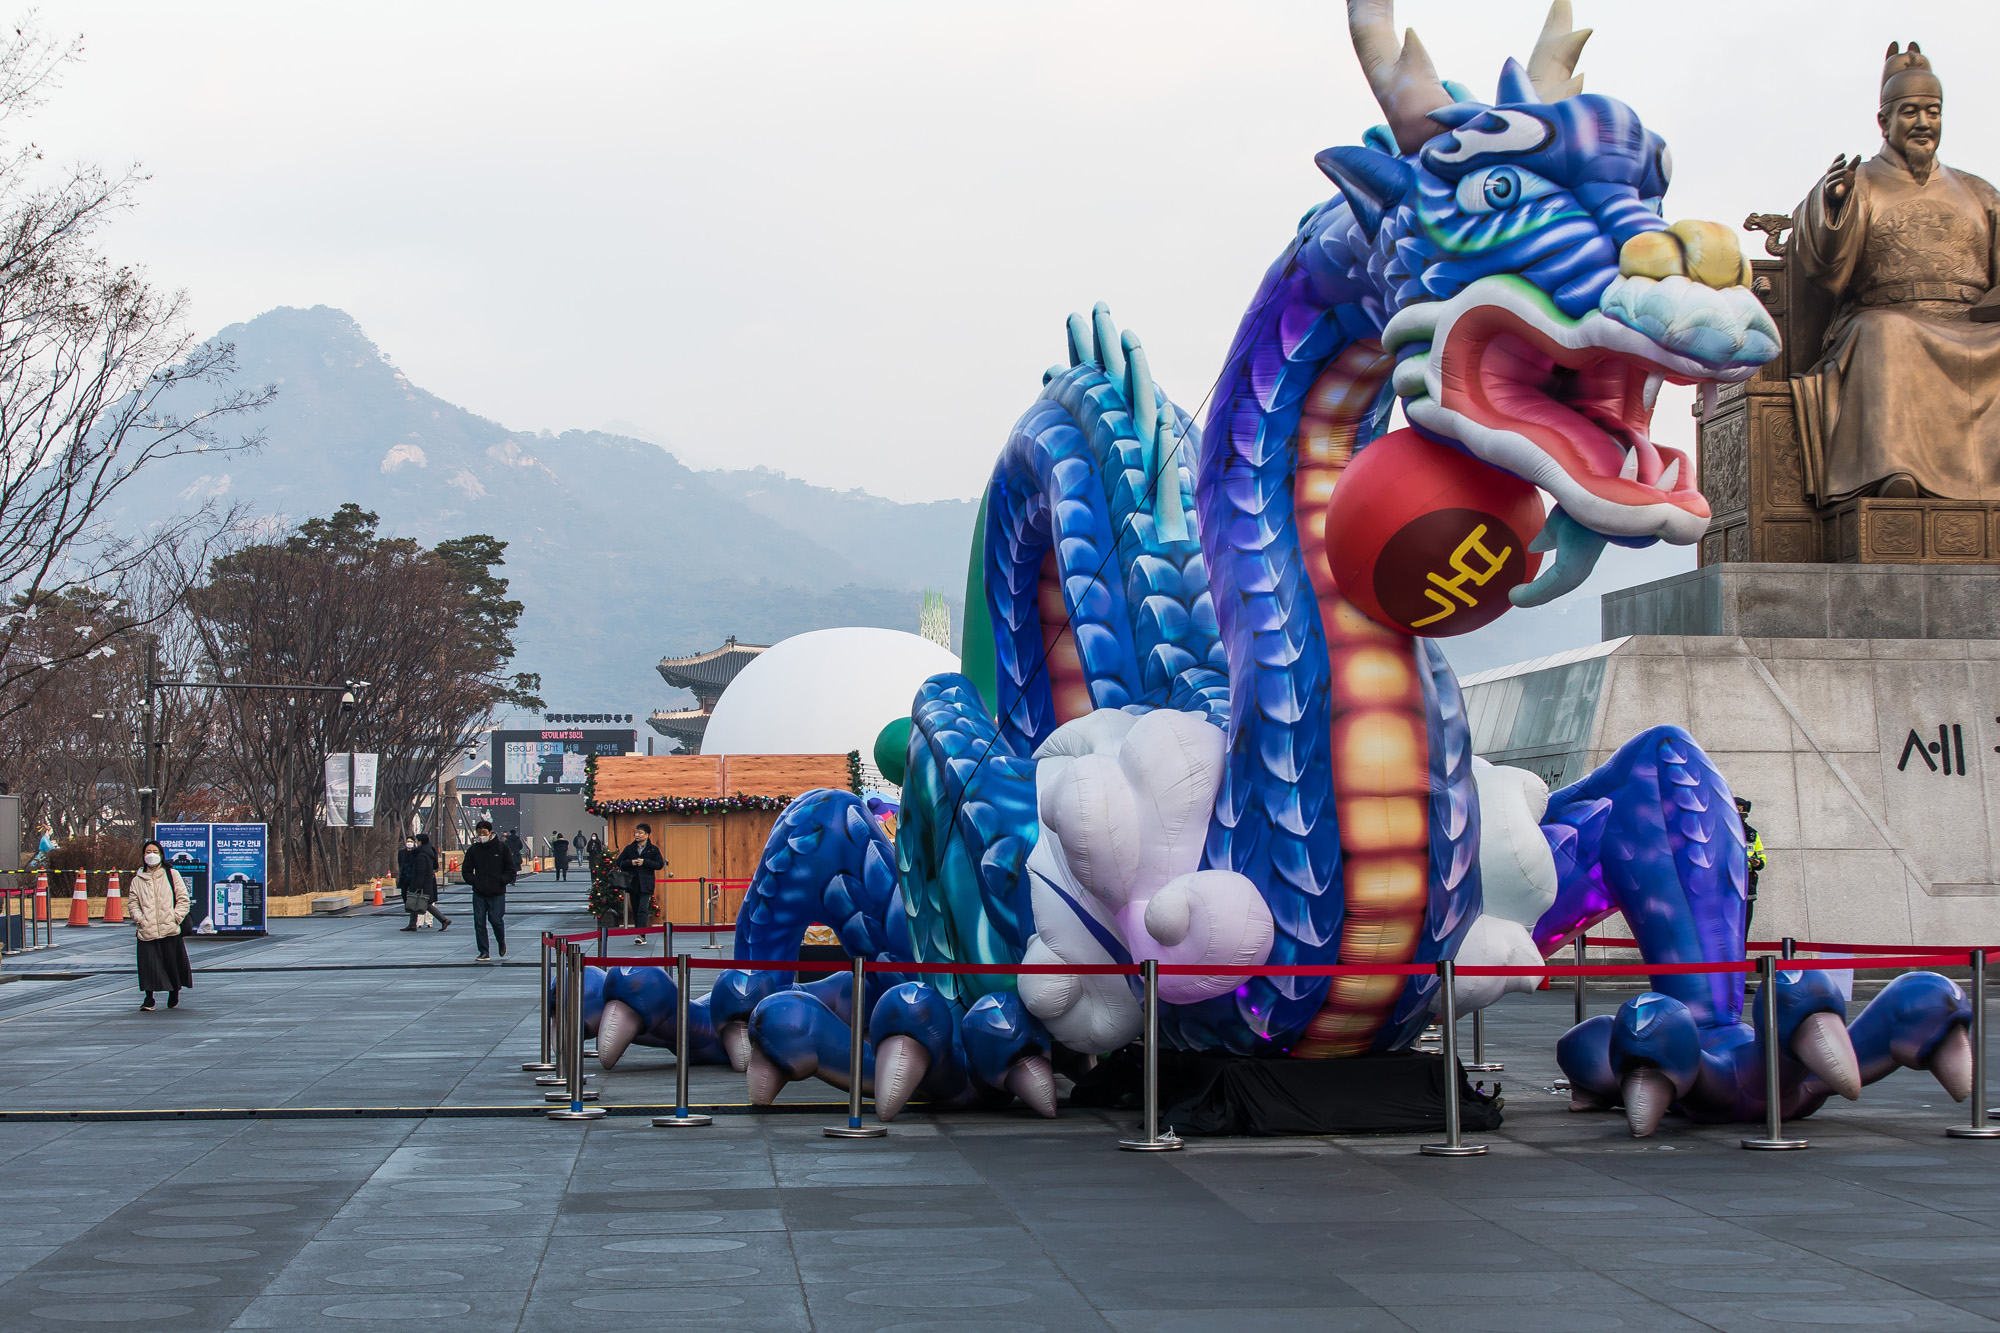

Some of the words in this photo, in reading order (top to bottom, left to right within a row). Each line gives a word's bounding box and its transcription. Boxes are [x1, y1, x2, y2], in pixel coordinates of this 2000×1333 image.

[1410, 523, 1512, 628] 복
[541, 731, 559, 739] SEOUL
[559, 731, 568, 739] MY
[568, 731, 584, 739] SOUL
[507, 743, 534, 753] Seoul
[536, 743, 559, 753] Light
[565, 743, 580, 752] 서울
[596, 743, 618, 752] 라이트
[1896, 715, 2000, 777] 세
[470, 797, 489, 806] SEOUL
[489, 797, 500, 806] MY
[499, 797, 516, 806] SOUL
